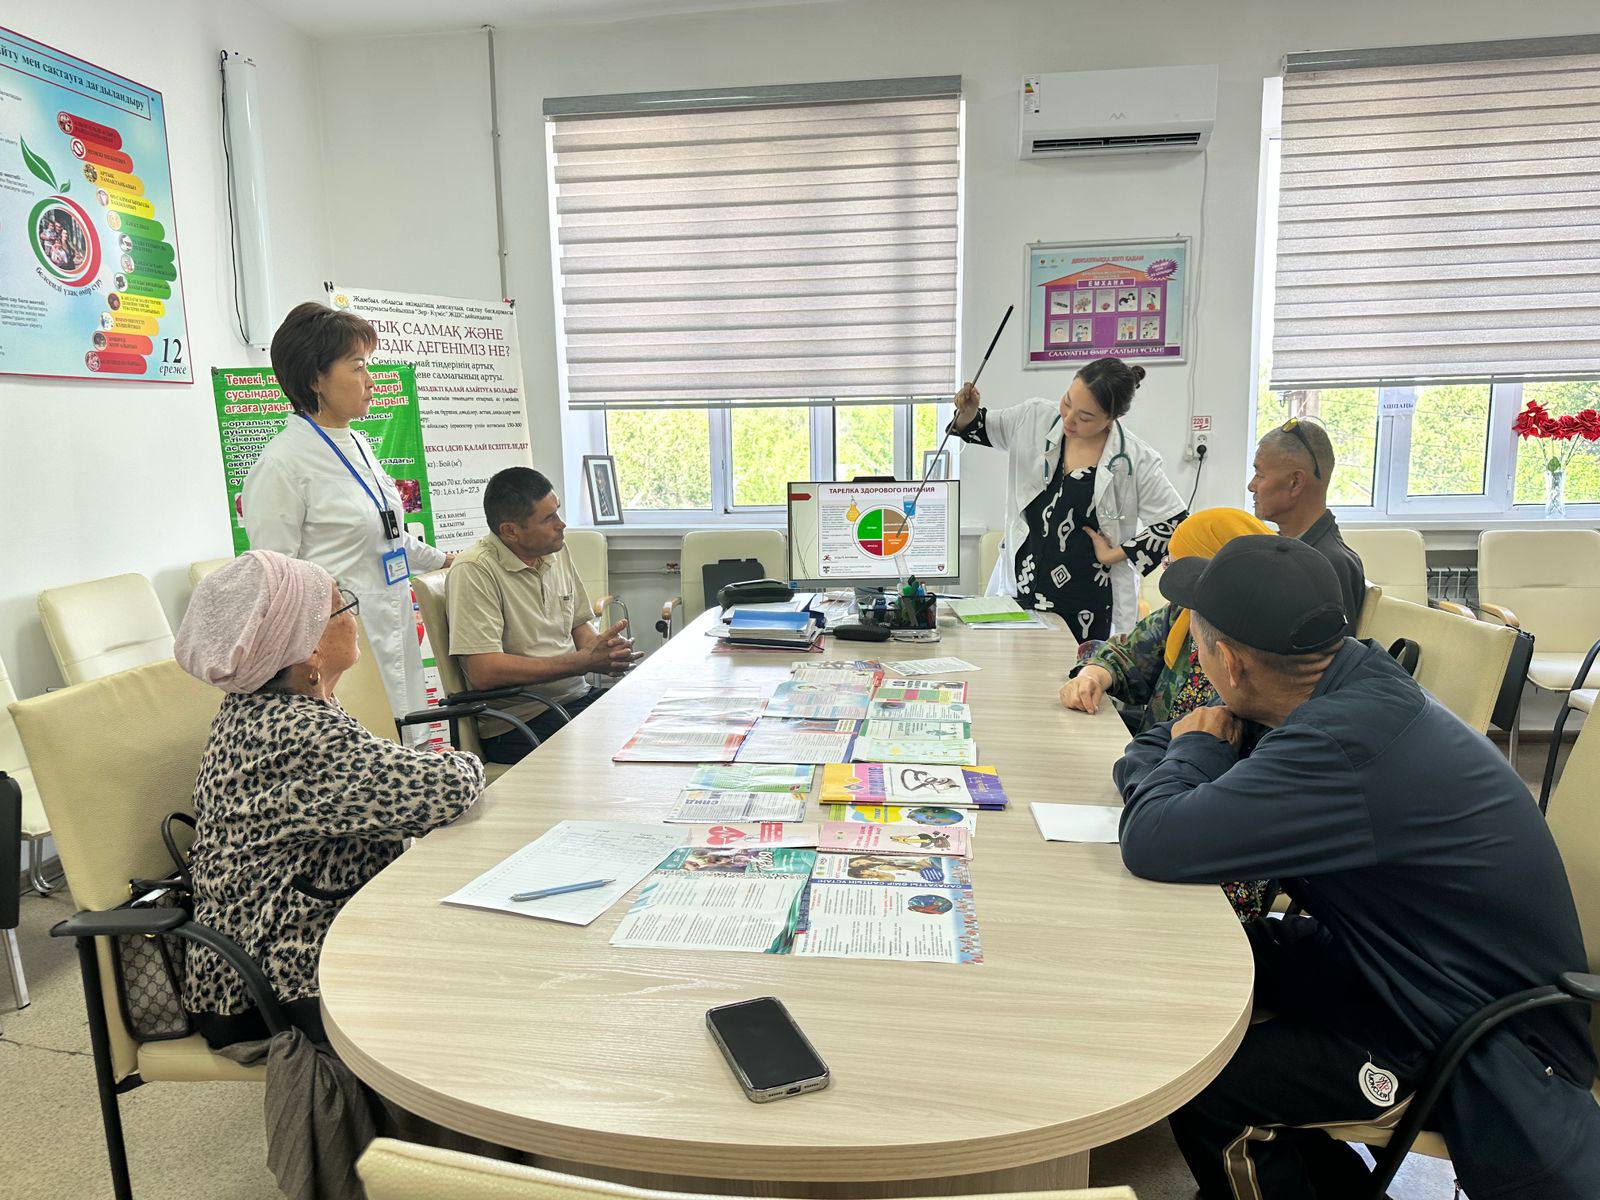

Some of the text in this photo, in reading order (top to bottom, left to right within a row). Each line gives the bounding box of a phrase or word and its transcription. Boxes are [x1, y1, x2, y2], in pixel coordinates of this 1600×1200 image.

[22, 56, 41, 69] мен
[353, 295, 379, 304] Жамбыл
[368, 320, 504, 340] ТЫҚ САЛМАҚ ЖӘНЕ
[162, 338, 182, 364] 12
[377, 338, 510, 357] ІЗДІК ДЕГЕНІМІЗ НЕ?
[1110, 347, 1138, 355] САЛТЫН
[159, 365, 187, 376] ереже
[370, 372, 399, 380] алық
[226, 374, 265, 386] Темекі,
[373, 382, 402, 393] мдері
[226, 390, 280, 401] сусындар
[371, 397, 408, 408] тырып:
[262, 403, 293, 414] уақыт
[229, 419, 271, 427] орталық
[240, 444, 265, 452] қоры
[903, 486, 935, 494] ПИТАНИЯ
[1367, 1072, 1388, 1099] MONCLER
